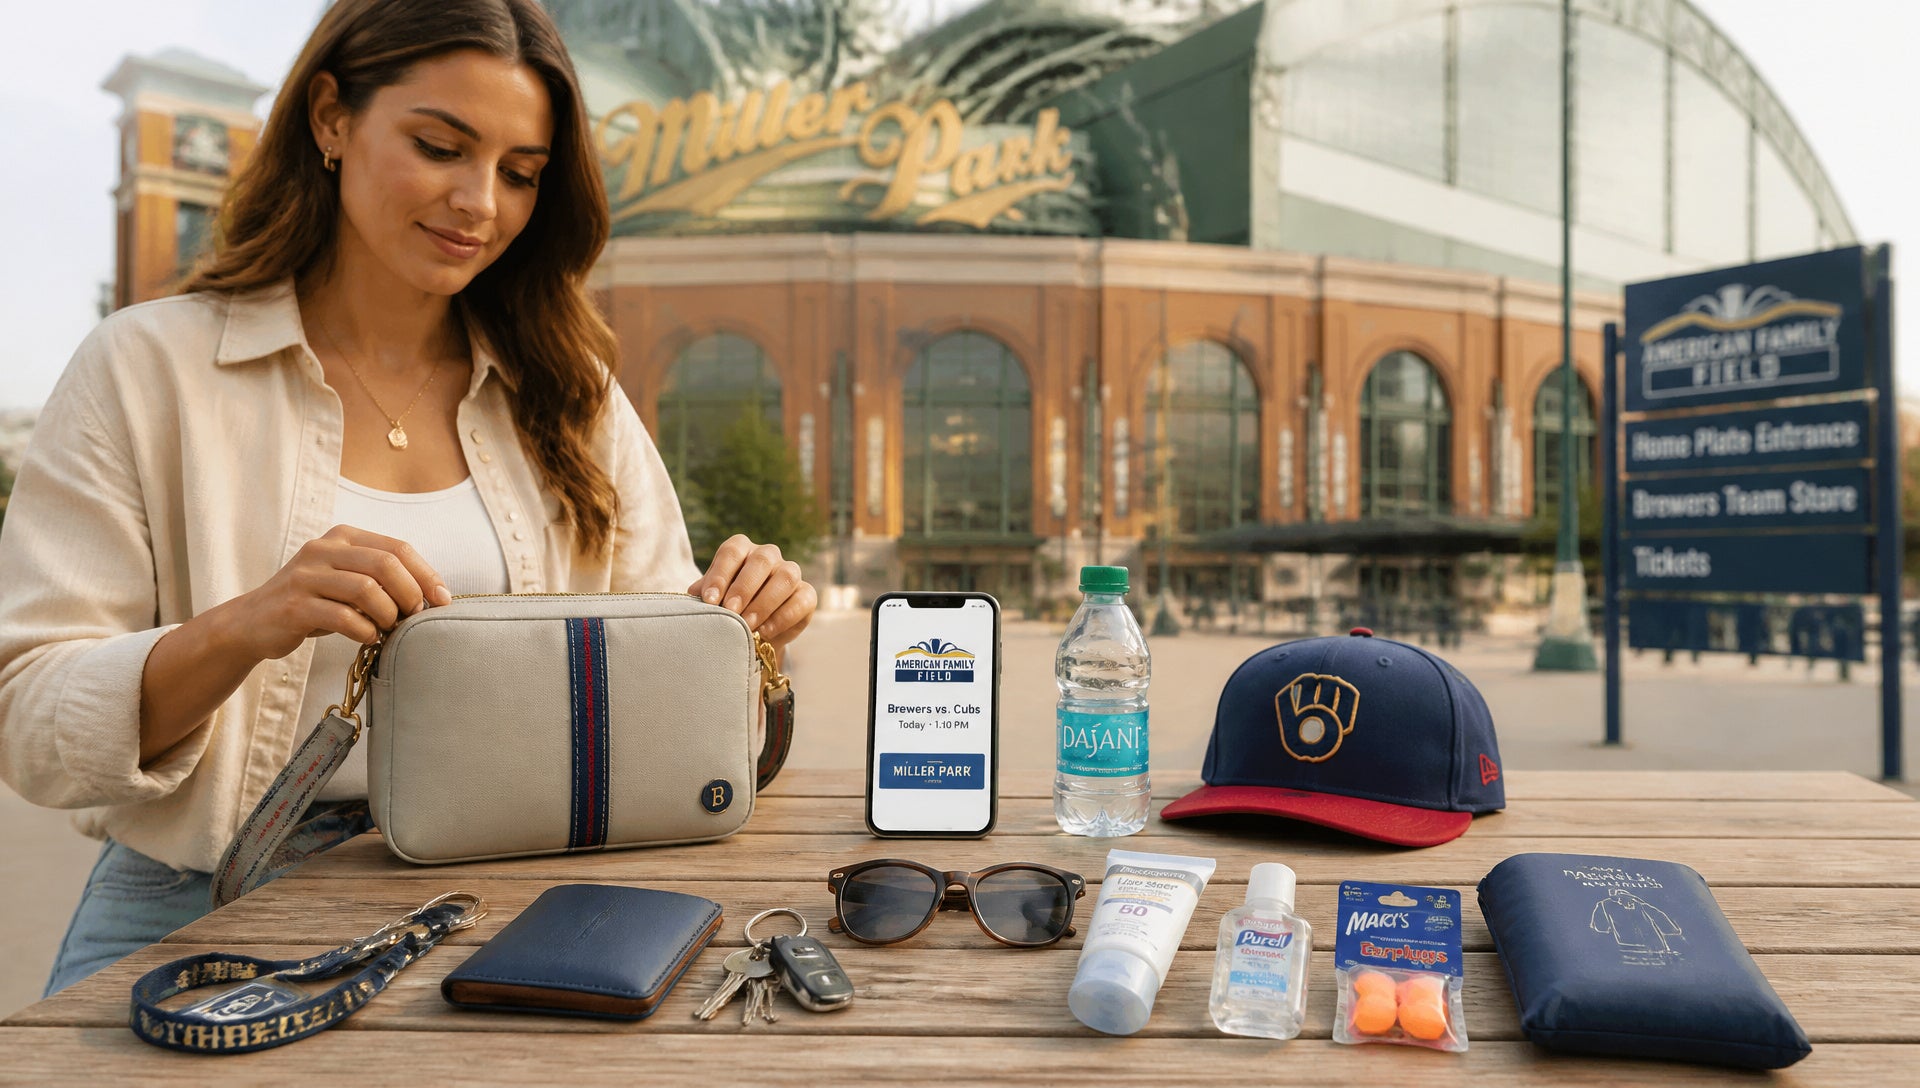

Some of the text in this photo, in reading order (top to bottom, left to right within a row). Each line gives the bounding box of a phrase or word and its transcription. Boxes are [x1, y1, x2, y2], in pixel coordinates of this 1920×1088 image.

[598, 79, 1074, 224] Miller Park
[1643, 317, 1840, 365] AMERICAN FAMILY
[1692, 353, 1780, 387] FIELD
[1632, 421, 1859, 461] Home Plate Entrance
[1632, 480, 1858, 519] Brewers Team Store
[1633, 546, 1712, 578] Tickets
[895, 659, 975, 669] AMERICAN FAMILY
[917, 671, 951, 681] FIELD
[887, 703, 981, 714] Brewers vs. Cubs
[899, 720, 926, 731] Today
[954, 721, 969, 729] PM
[893, 765, 935, 777] MILLER
[711, 786, 725, 807] B
